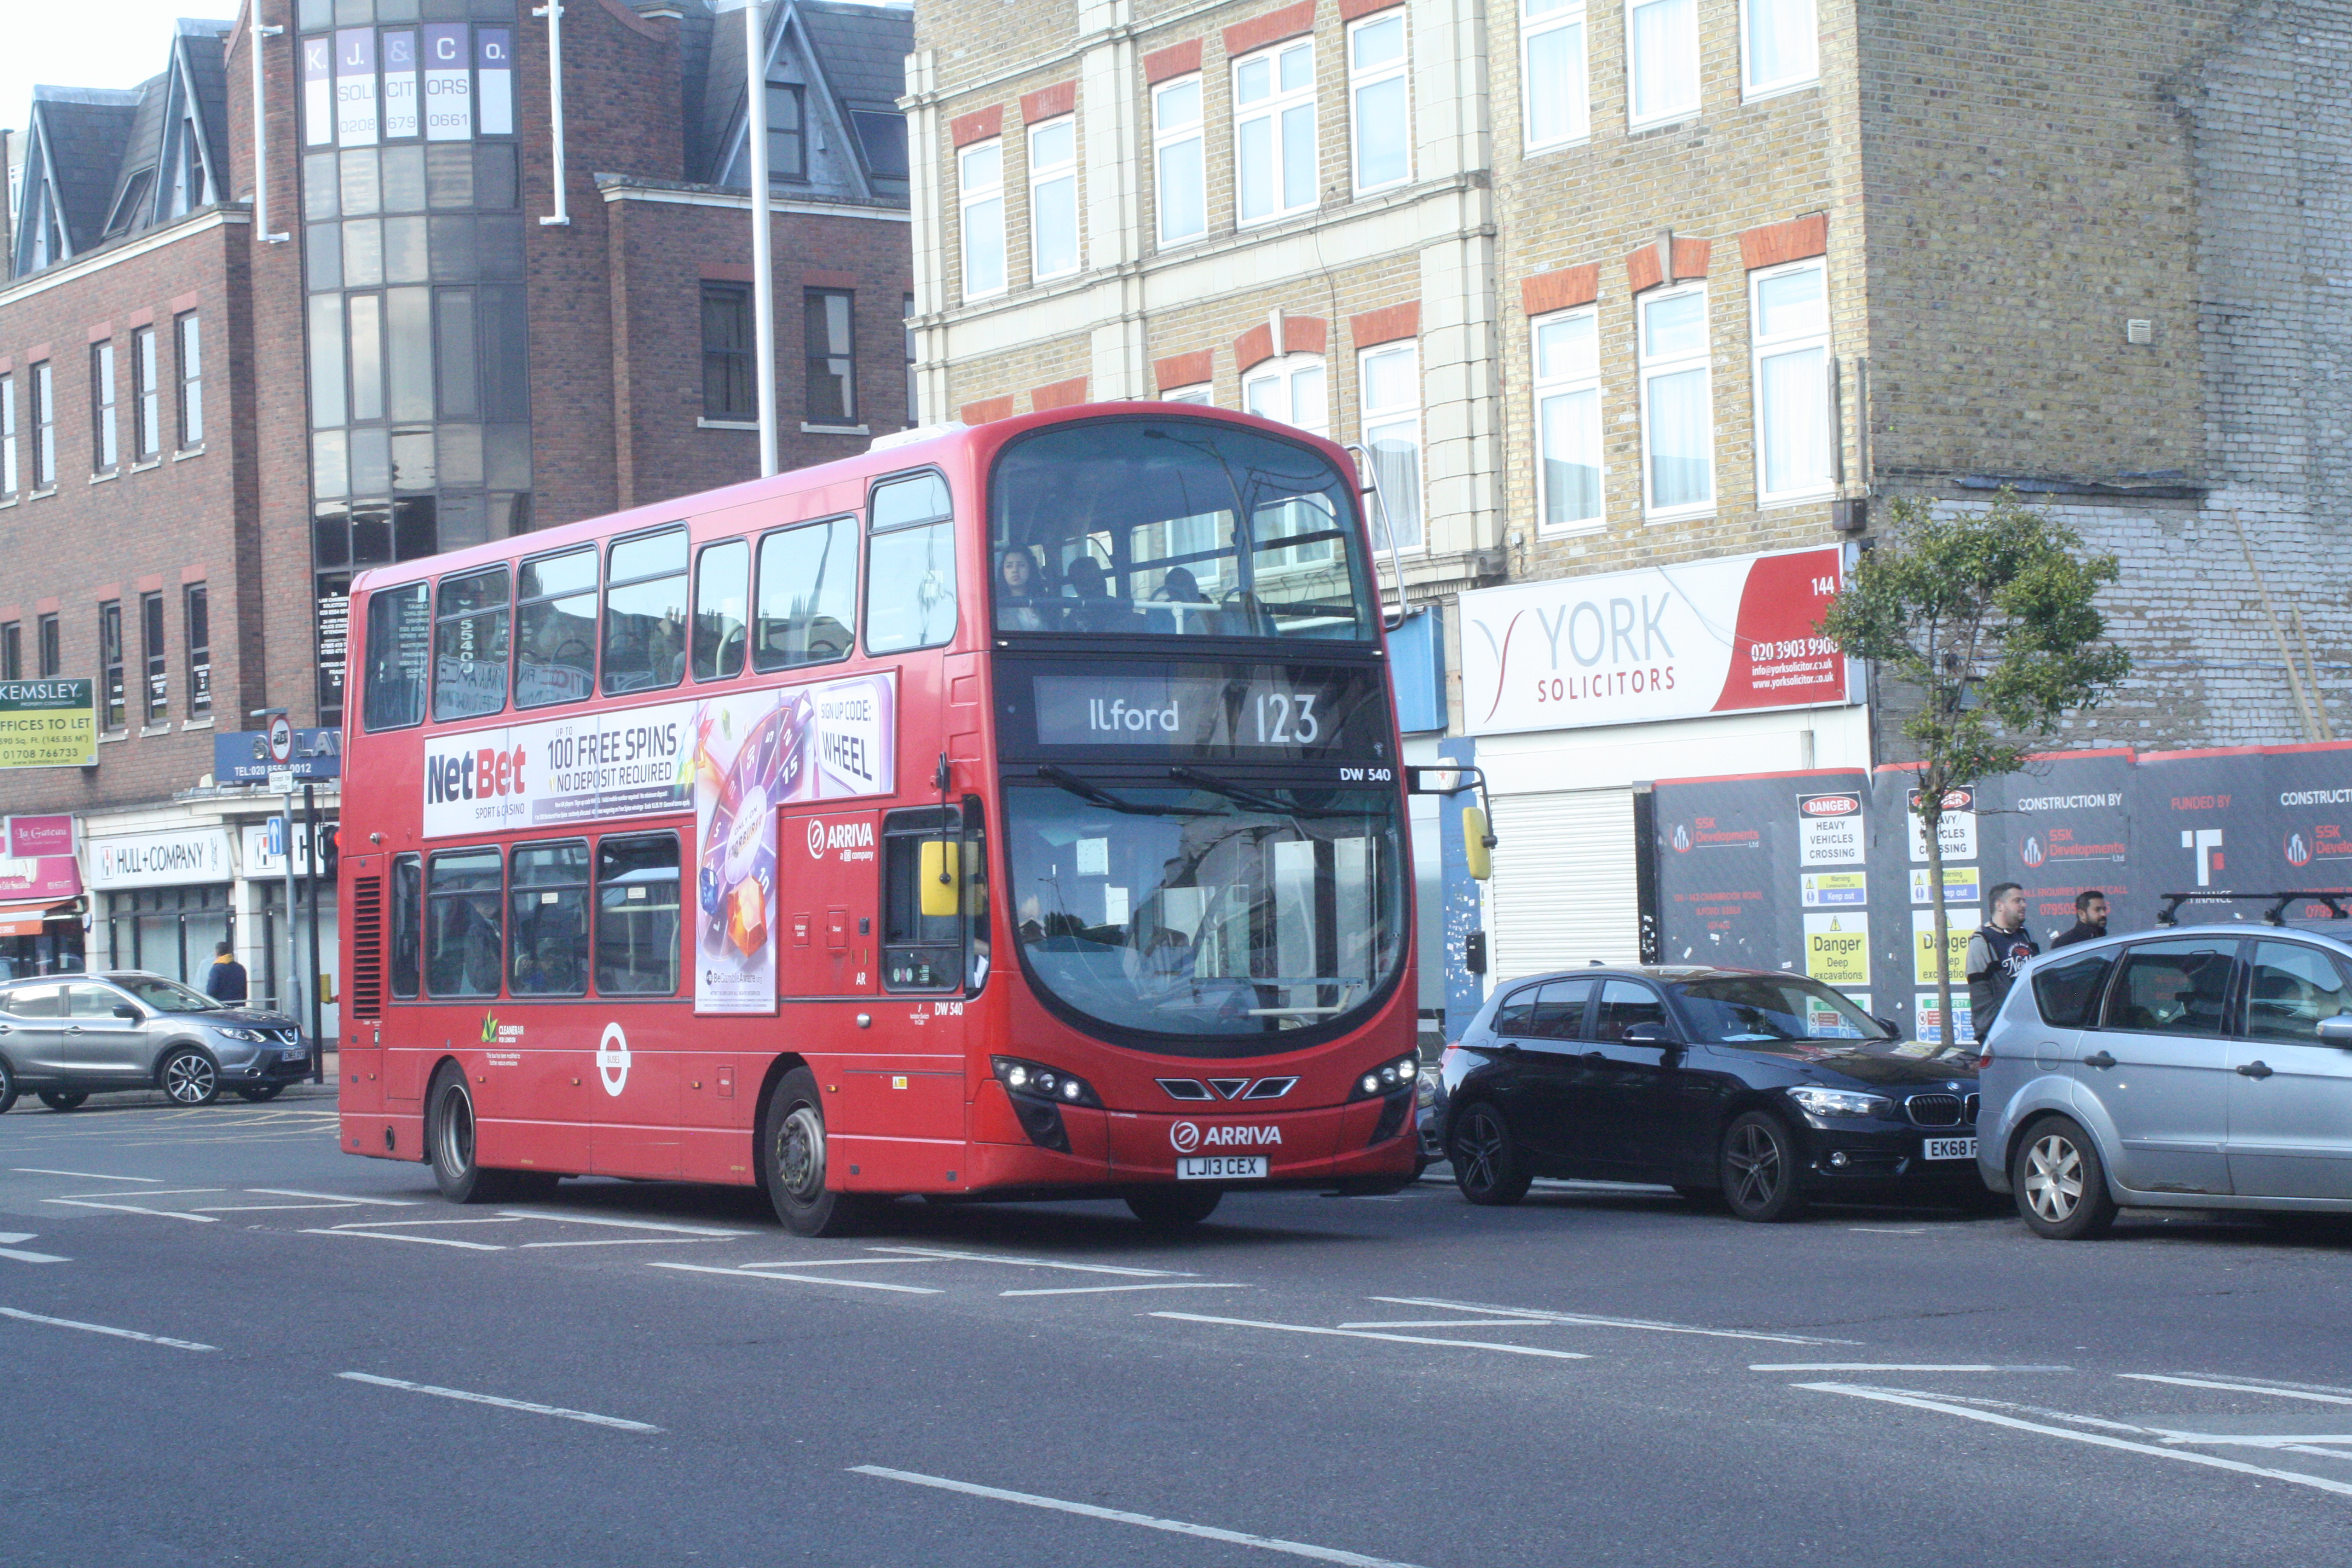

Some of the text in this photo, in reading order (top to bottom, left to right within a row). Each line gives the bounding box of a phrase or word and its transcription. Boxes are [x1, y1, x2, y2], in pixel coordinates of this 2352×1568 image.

[307, 48, 327, 71] K.
[347, 43, 364, 66] J.
[390, 41, 411, 62] &
[339, 114, 468, 134] 0208 679 0661
[1811, 576, 1834, 596] 144
[1536, 592, 1675, 671] YORK
[1751, 642, 1774, 662] 020
[1776, 639, 1805, 659] 3903
[1752, 658, 1833, 676] info@yorksolicitor.co.uk
[1538, 666, 1675, 703] SOLICITORS
[1752, 671, 1834, 690] www.yorksolicitor.co.uk
[0, 683, 79, 700] KEMSLEY
[822, 699, 871, 722] SIGN UP CODE:
[1089, 694, 1318, 743] Ilford 123
[48, 719, 66, 730] TO
[71, 718, 90, 728] LET
[555, 727, 573, 737] UP TO
[3, 748, 78, 759] 01708 766733
[548, 723, 676, 770] 100 FREE SPINS
[822, 731, 872, 782] WHEEL
[428, 743, 526, 805] NetBet
[557, 762, 671, 792] NO DEPOSIT REQUIRED
[1341, 768, 1391, 782] DW 540
[1809, 800, 1851, 812] DANGER
[2018, 793, 2122, 811] CONSTRUCTION BY
[2171, 794, 2232, 810] FUNDED BY
[475, 806, 495, 819] SPORT
[497, 807, 500, 817] &
[501, 803, 524, 817] CASINO
[1696, 817, 1716, 829] SSK
[1816, 821, 1846, 831] HEAVY
[827, 823, 874, 849] ARRIVA
[1696, 829, 1760, 843] Developments
[1809, 834, 1854, 844] VEHICLES
[2050, 829, 2073, 841] SSK
[2314, 825, 2341, 838] SSK
[1809, 848, 1855, 859] CROSSING
[2050, 842, 2125, 856] Developments
[1700, 892, 1740, 901] CRANBROOK
[1828, 892, 1843, 901] Keep
[2037, 887, 2075, 897] ENQUIRIES
[2107, 886, 2128, 894] CALL
[1814, 936, 1861, 955] Danger
[1827, 957, 1848, 969] Deep
[856, 972, 866, 985] AR
[1814, 970, 1863, 980] excavations
[935, 1002, 963, 1016] DW 540
[1203, 1126, 1282, 1145] ARRIVA
[1931, 1140, 1967, 1158] EK68
[1187, 1158, 1256, 1175] LJ13 CEX
